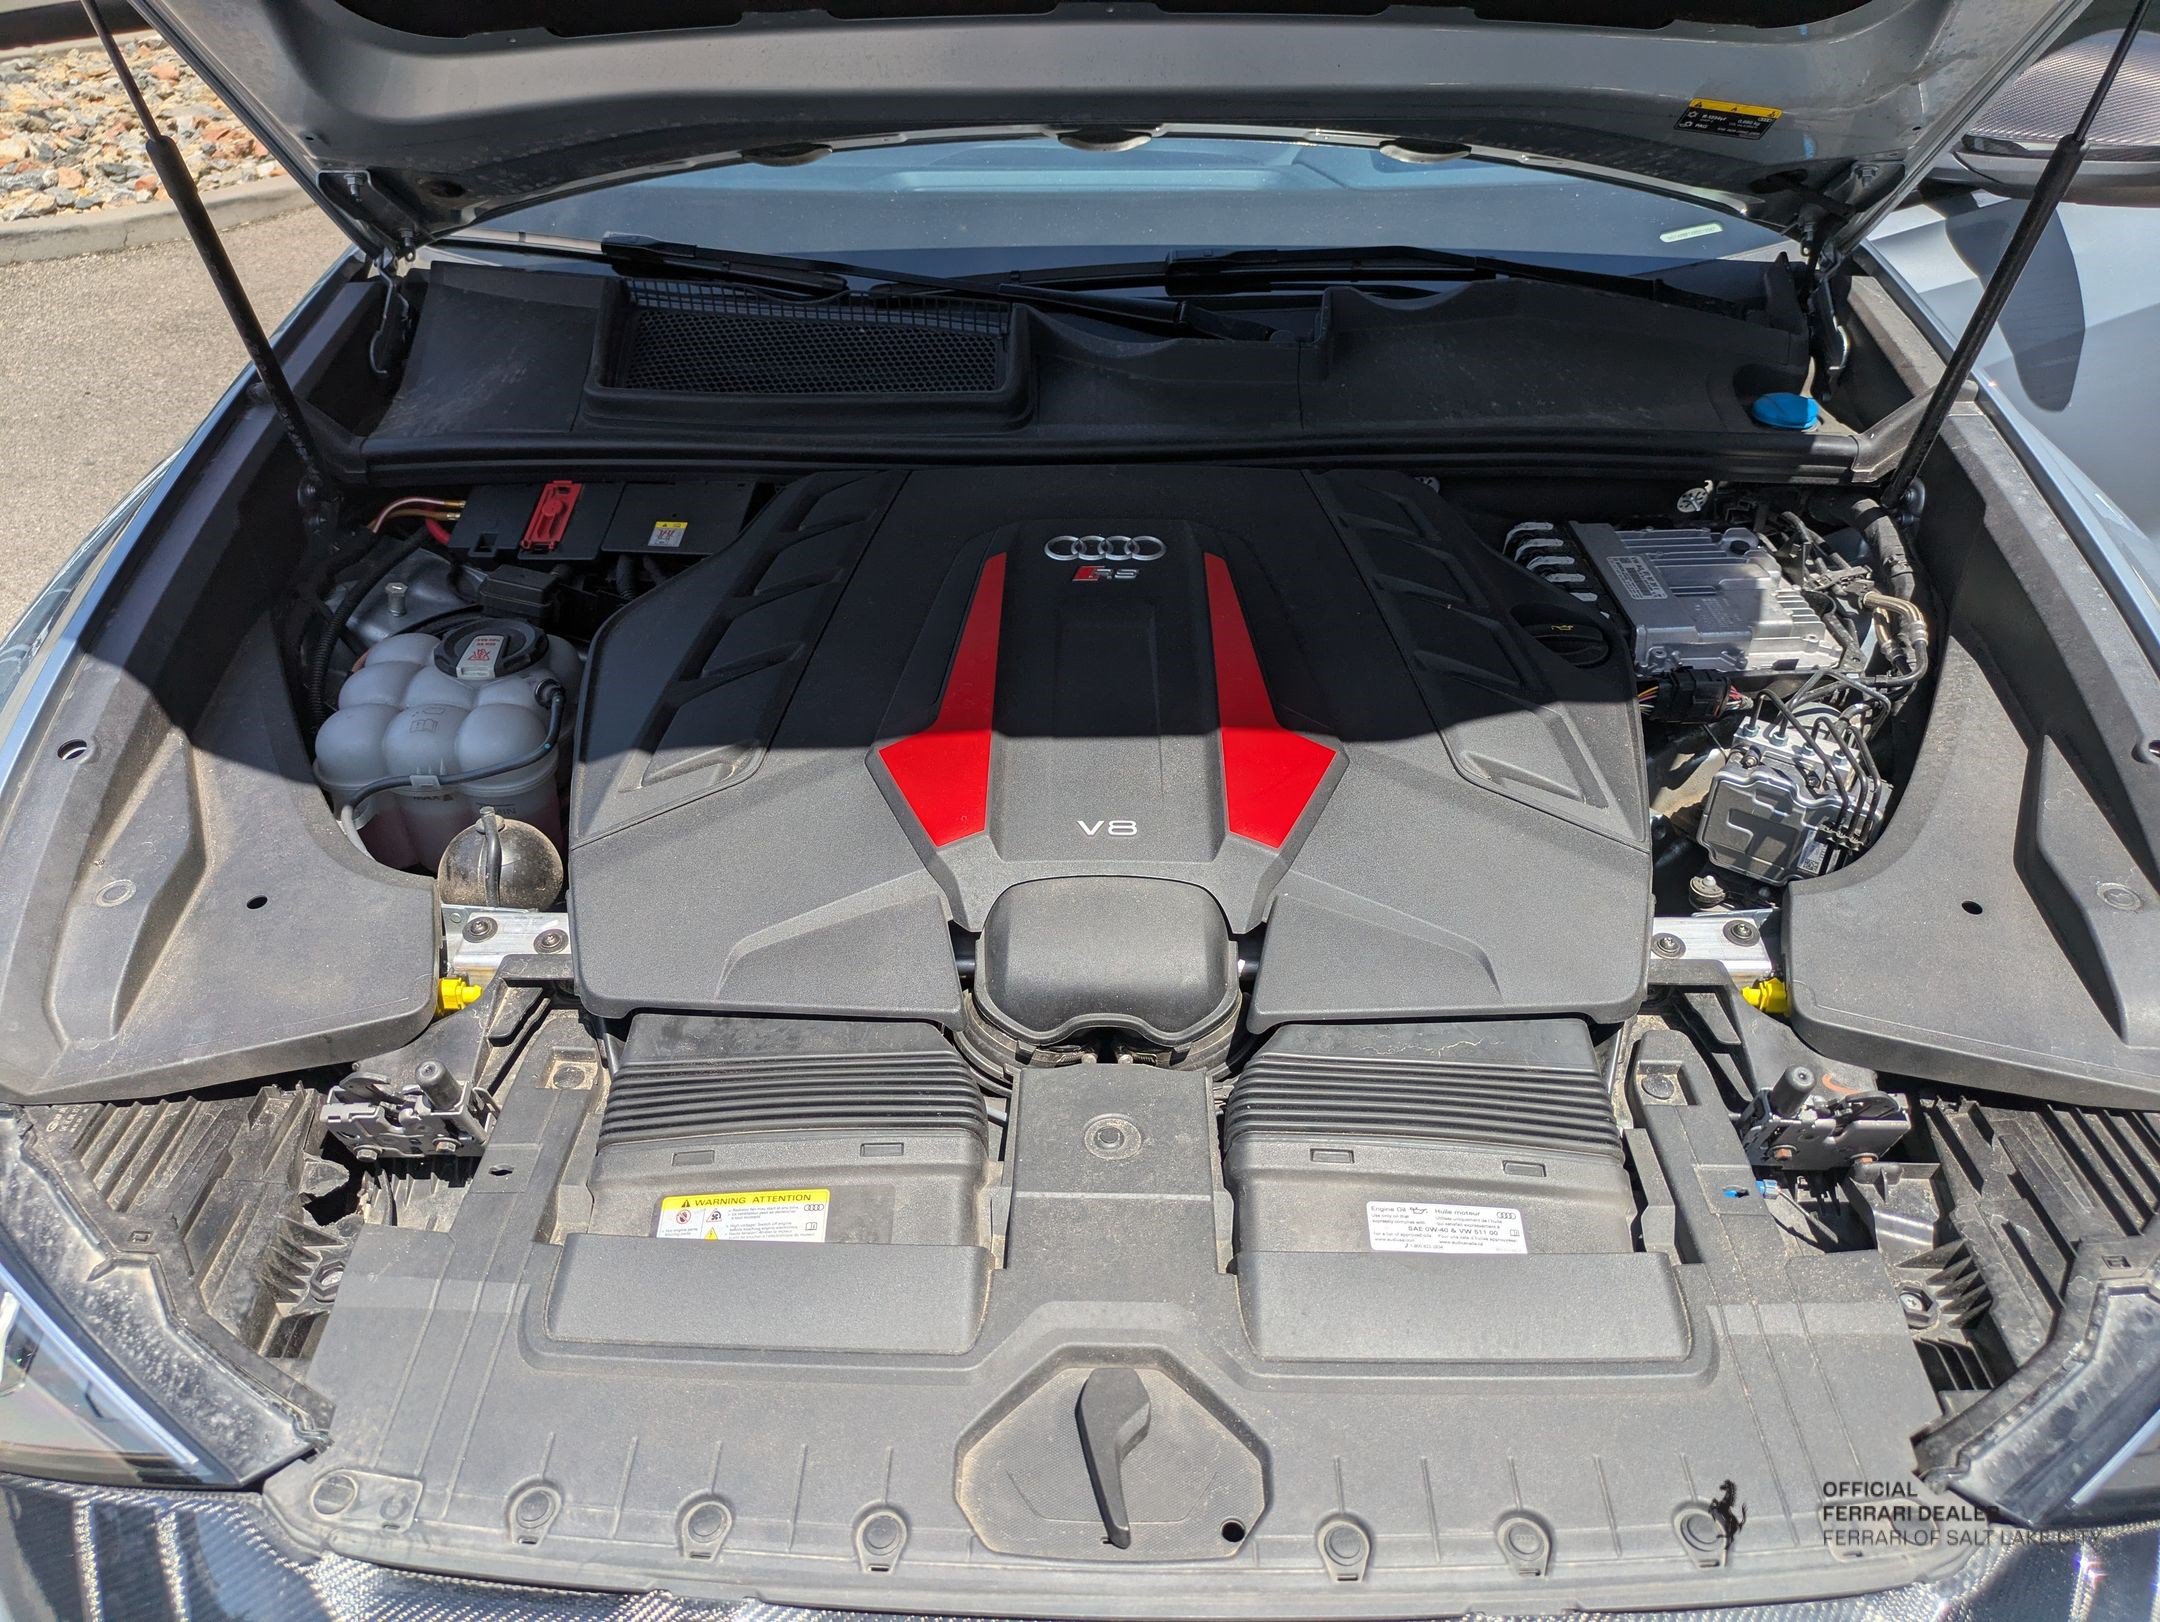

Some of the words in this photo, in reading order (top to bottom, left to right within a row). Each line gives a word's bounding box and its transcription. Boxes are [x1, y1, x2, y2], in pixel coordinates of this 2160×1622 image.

[1077, 820, 1137, 836] V8
[695, 1196, 746, 1206] WARNING
[751, 1194, 812, 1204] ATTENTION
